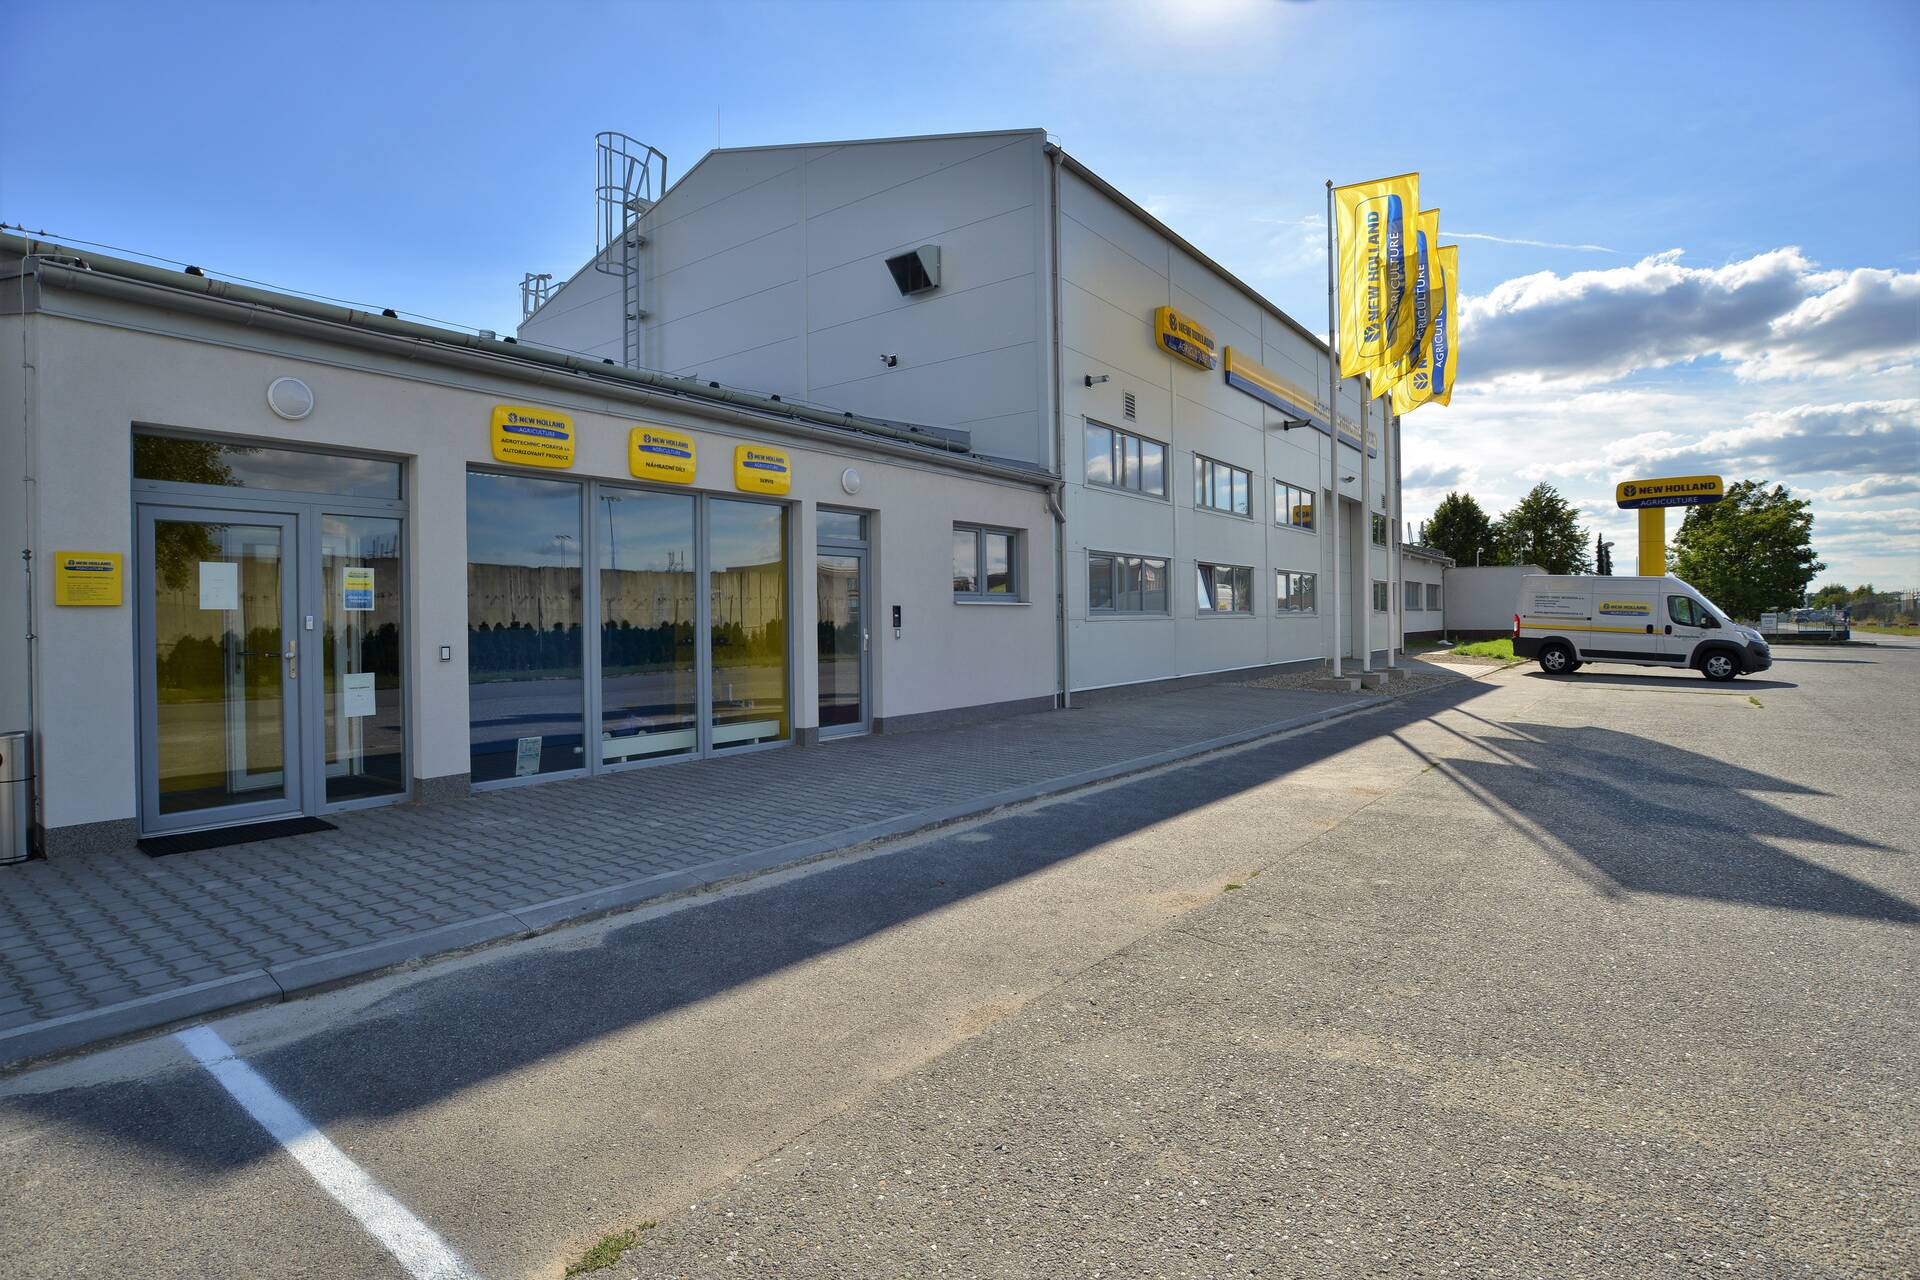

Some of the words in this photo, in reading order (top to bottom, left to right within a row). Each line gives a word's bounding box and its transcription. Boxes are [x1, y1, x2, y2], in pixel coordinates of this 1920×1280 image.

[1367, 211, 1380, 281] HOLLAND
[1367, 286, 1379, 321] NEW
[1178, 321, 1191, 336] NEW
[1191, 328, 1215, 350] HOLLAND
[519, 416, 535, 424] NEW
[536, 419, 565, 429] HOLLAND
[665, 439, 688, 448] HOLLAND
[1639, 485, 1663, 495] NEW
[1665, 482, 1716, 493] HOLLAND
[1640, 496, 1698, 506] AGRICULTURE
